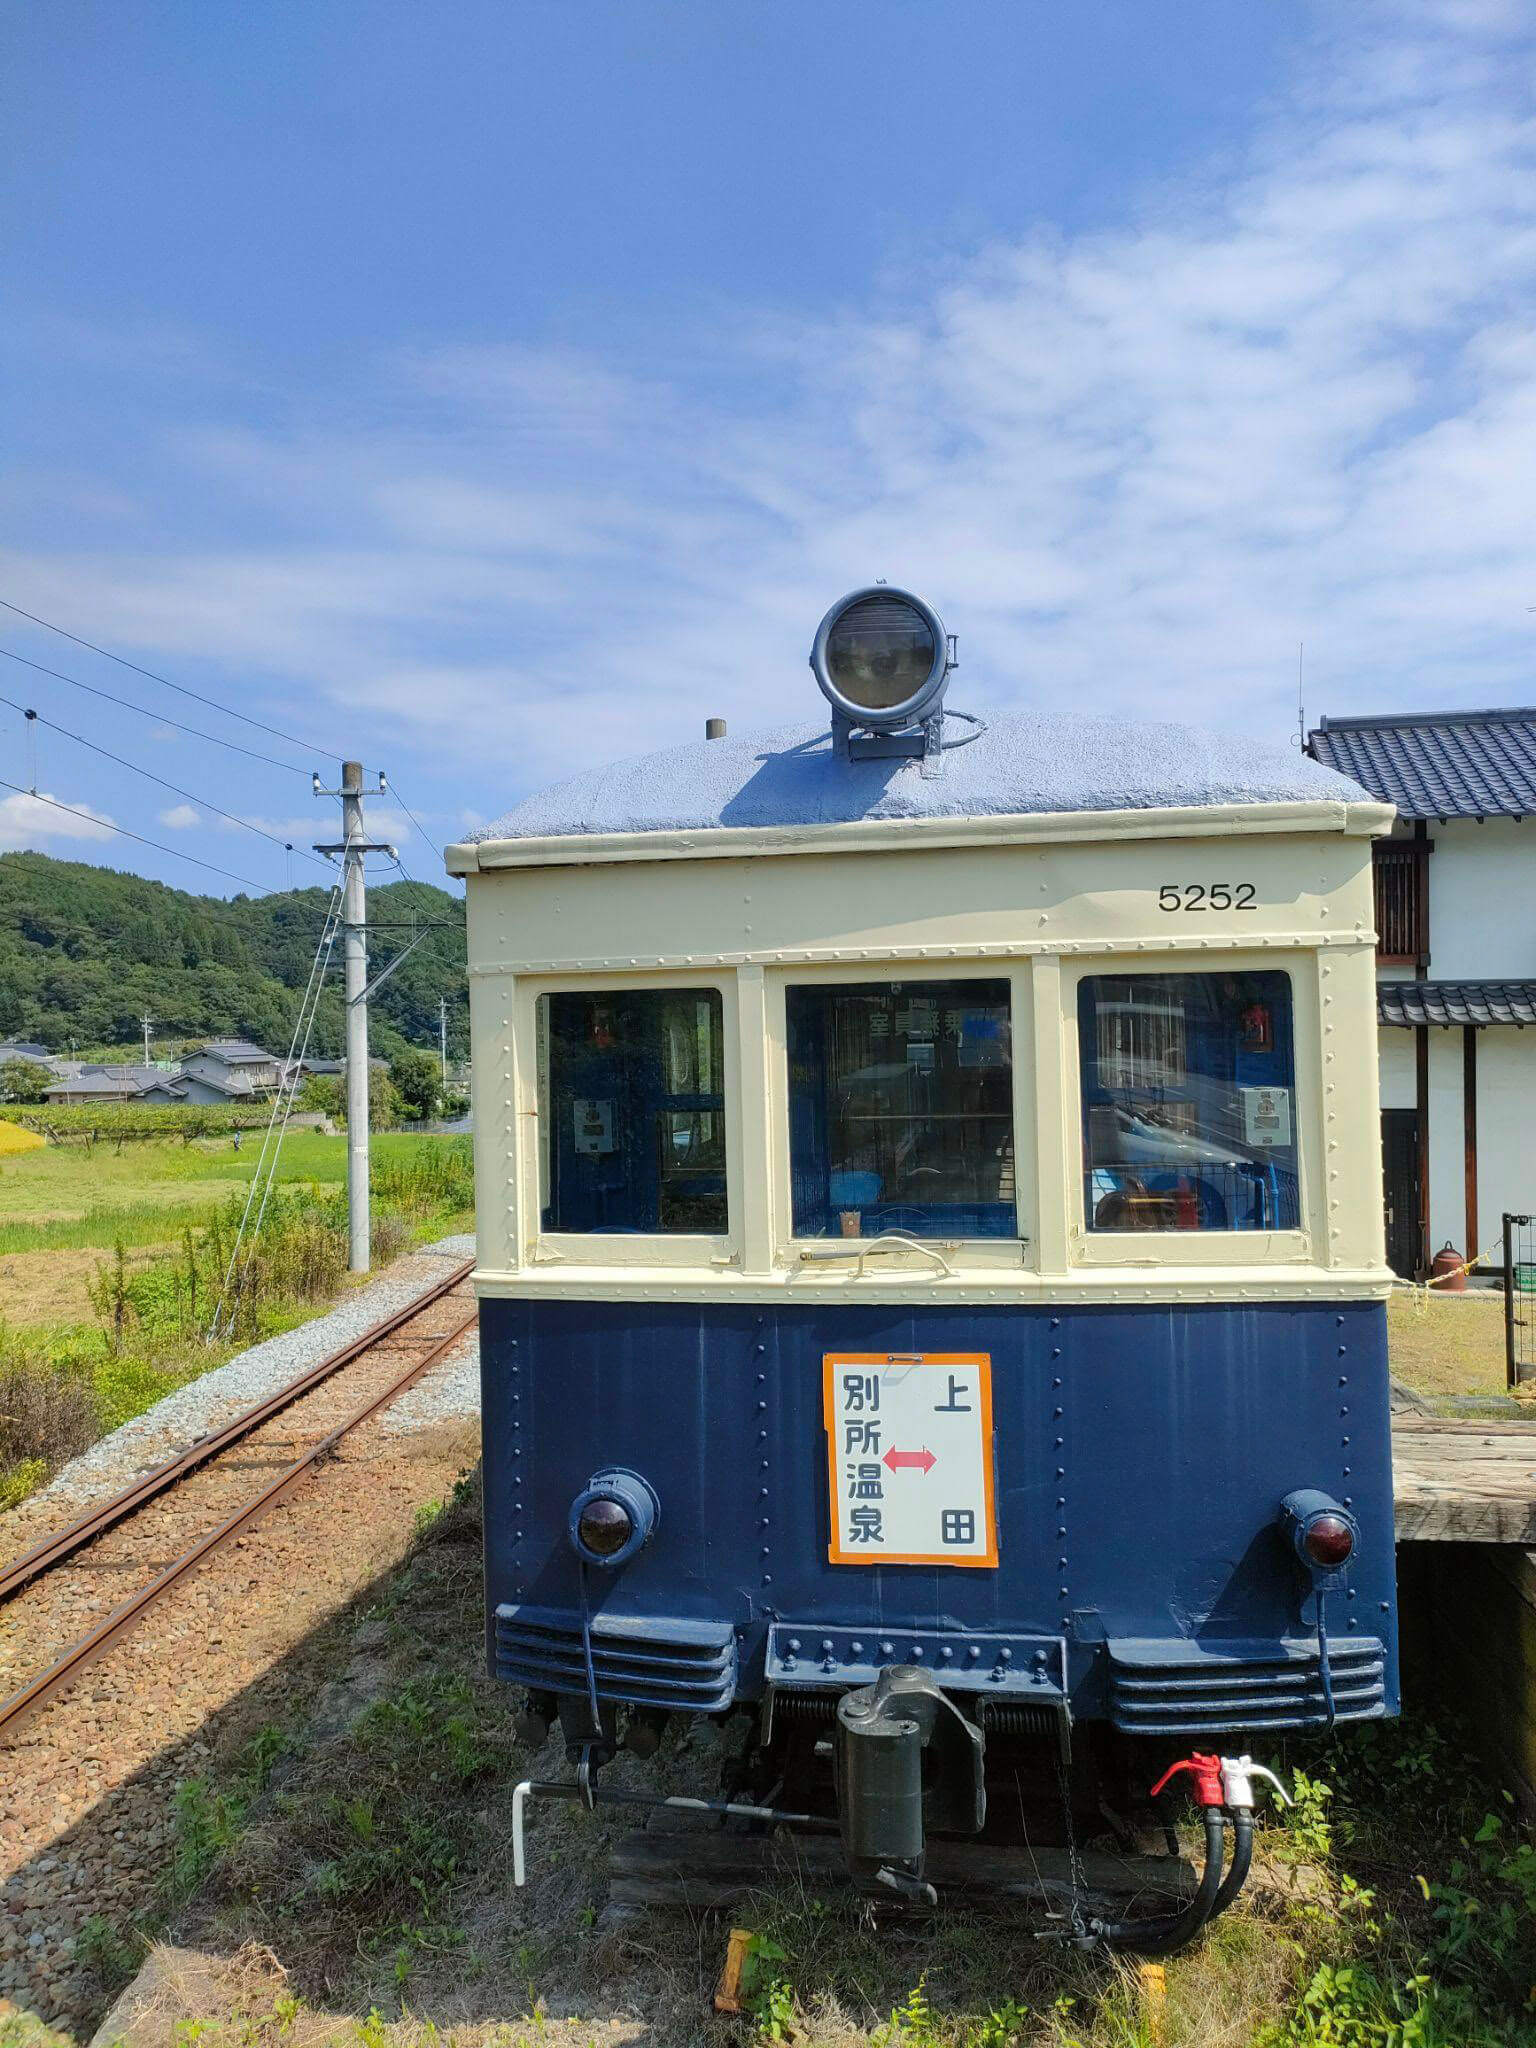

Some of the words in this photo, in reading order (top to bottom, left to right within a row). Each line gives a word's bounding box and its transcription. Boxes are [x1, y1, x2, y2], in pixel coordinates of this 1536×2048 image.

[1159, 883, 1257, 912] 5252
[843, 1374, 885, 1543] 別所温泉
[934, 1374, 975, 1544] 上田
